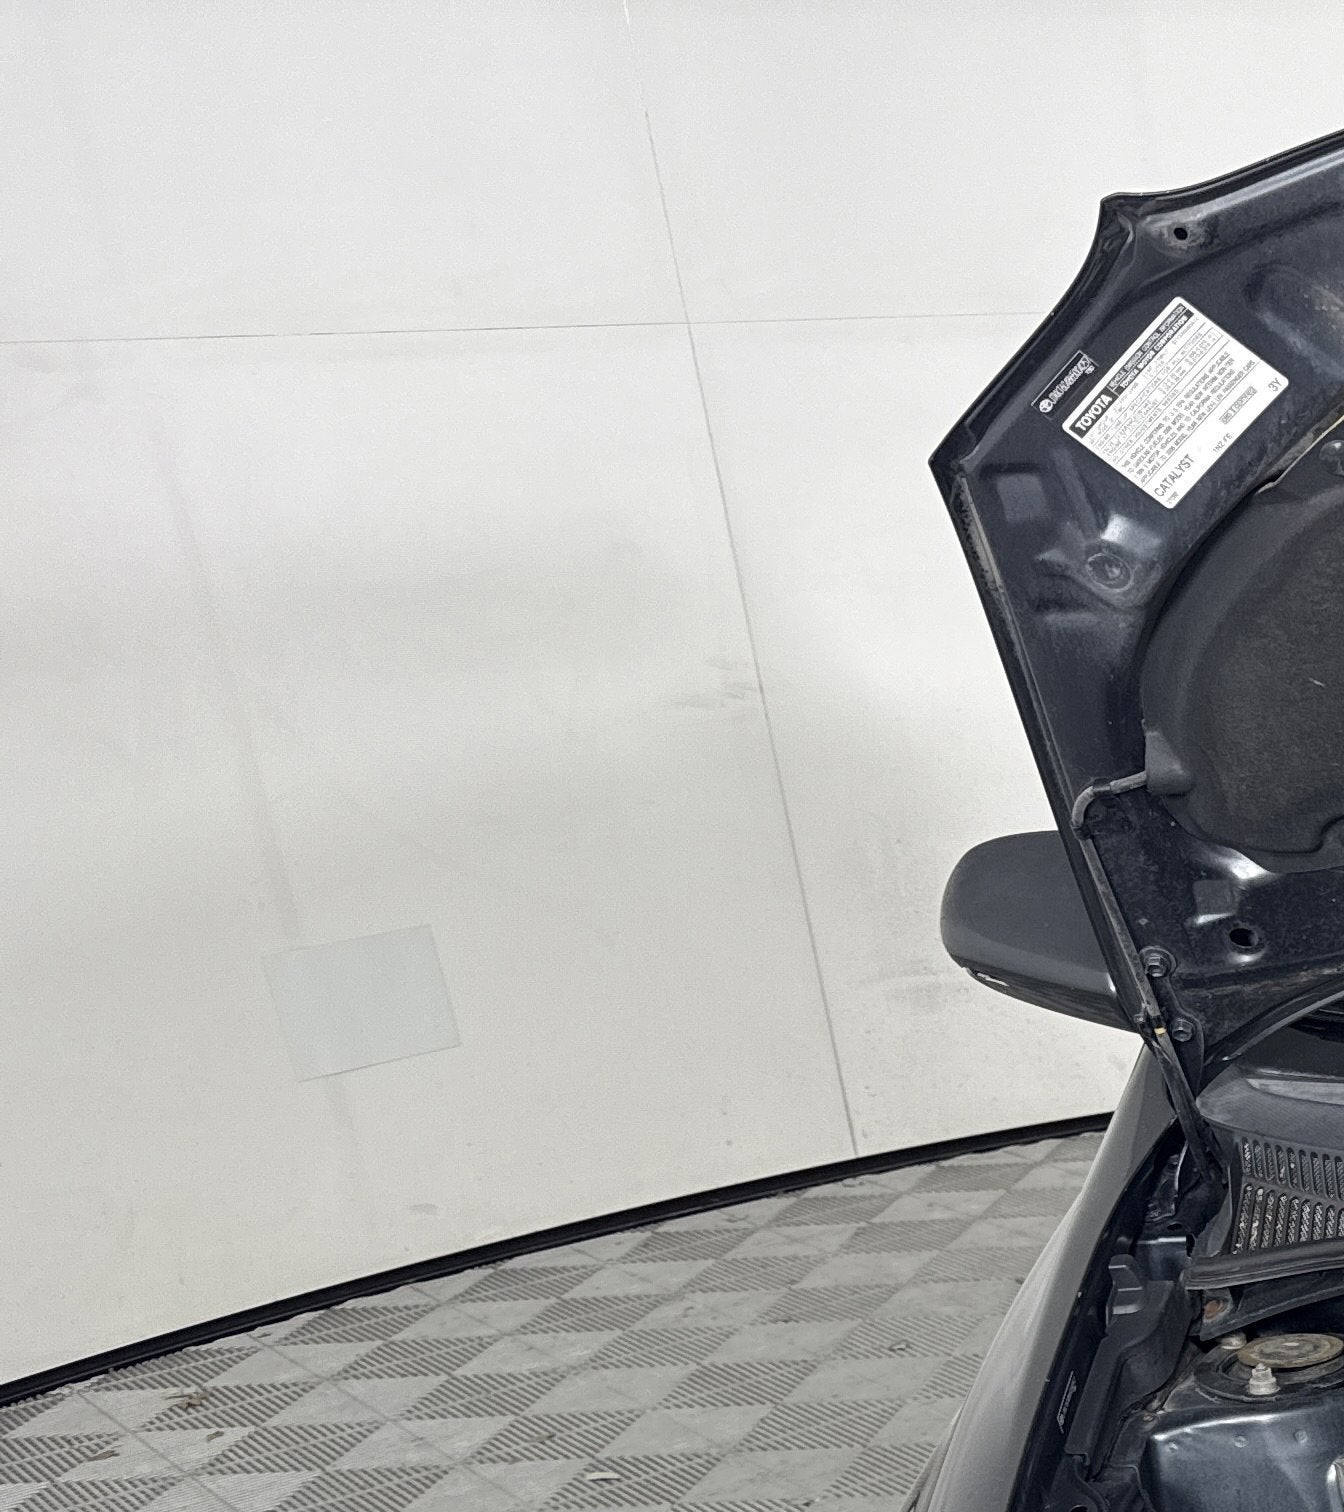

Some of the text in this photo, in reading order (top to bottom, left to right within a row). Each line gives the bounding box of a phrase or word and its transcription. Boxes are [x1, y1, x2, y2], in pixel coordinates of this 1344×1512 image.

[1108, 368, 1127, 389] VEHICLE
[1140, 330, 1161, 352] CONTROL
[1119, 313, 1189, 389] TOYOTA MOTOR CORPORATION
[1267, 376, 1283, 393] 3Y
[1073, 391, 1114, 433] TOYOTA
[1152, 452, 1195, 499] CATALYST
